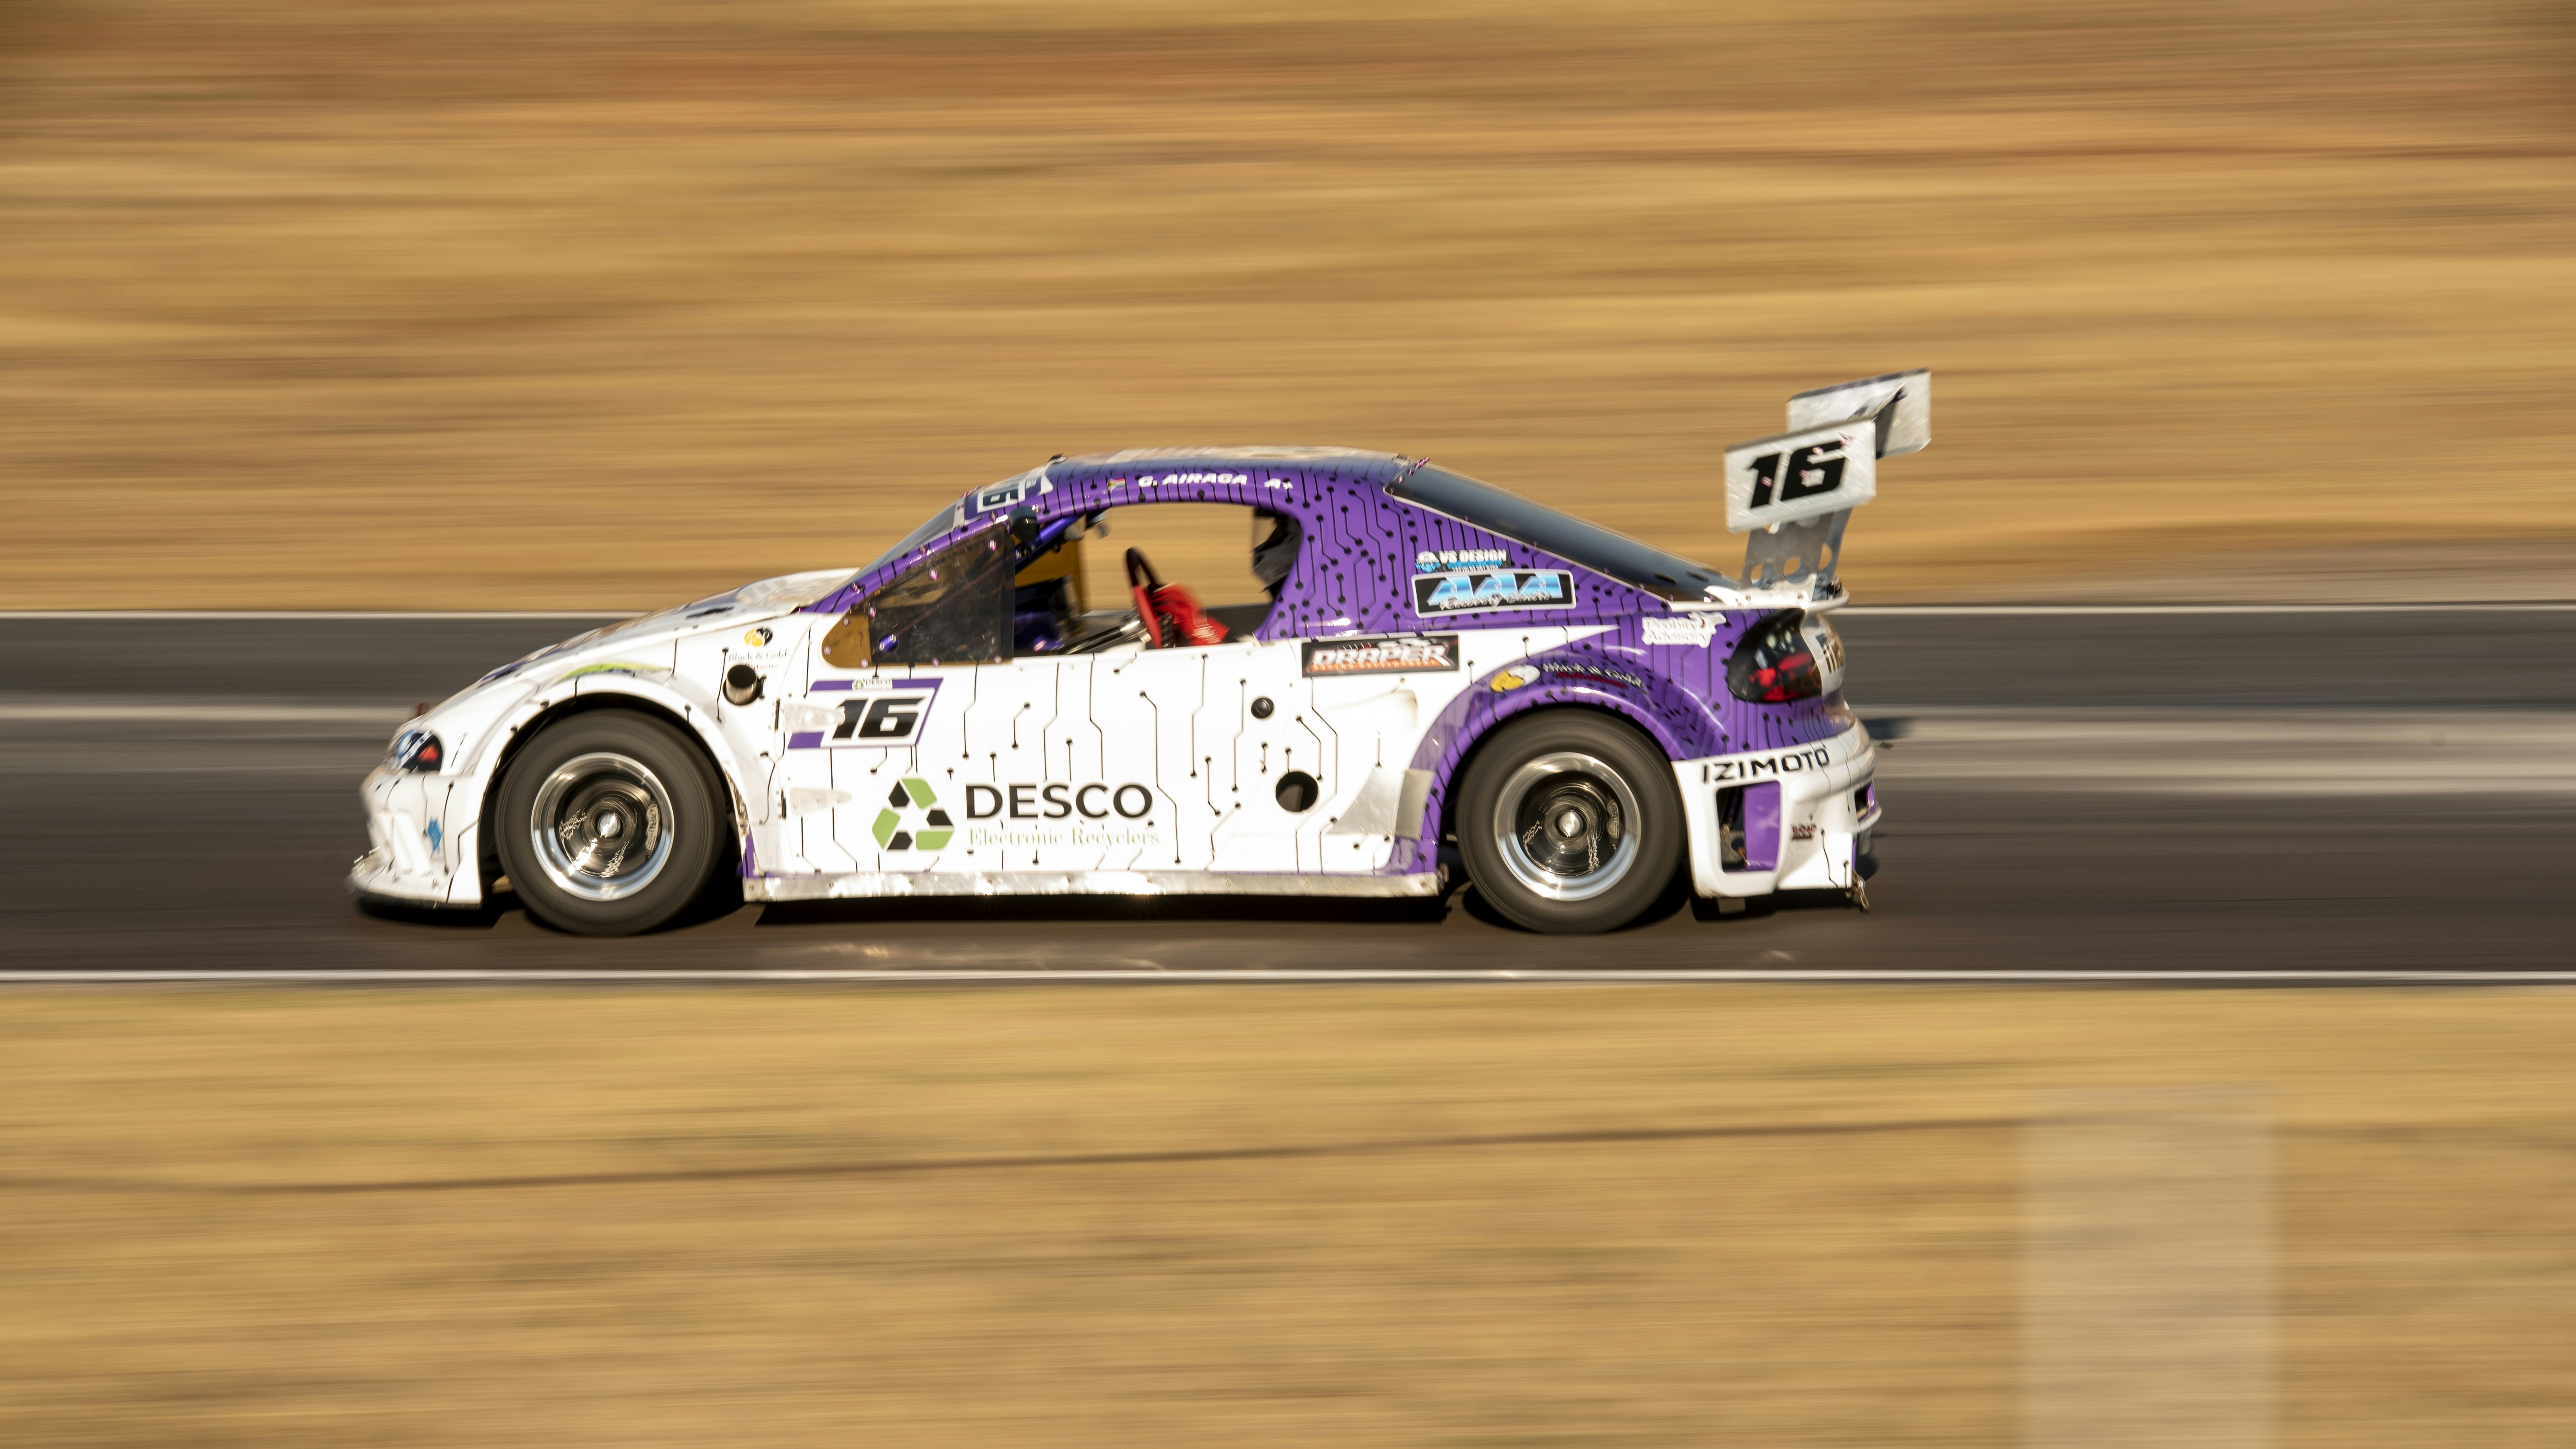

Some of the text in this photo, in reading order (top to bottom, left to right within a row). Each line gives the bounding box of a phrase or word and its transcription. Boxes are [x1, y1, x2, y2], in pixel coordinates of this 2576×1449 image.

[1747, 439, 1849, 509] 16
[1439, 550, 1458, 564] VS
[1458, 549, 1507, 563] DESIGN
[1427, 571, 1563, 606] AAA
[1313, 645, 1454, 667] DRAPER
[831, 697, 925, 739] 16
[1703, 749, 1830, 784] IZIMOTO
[965, 783, 1152, 818] DESCO
[968, 828, 1159, 851] Electronic Recyclers
